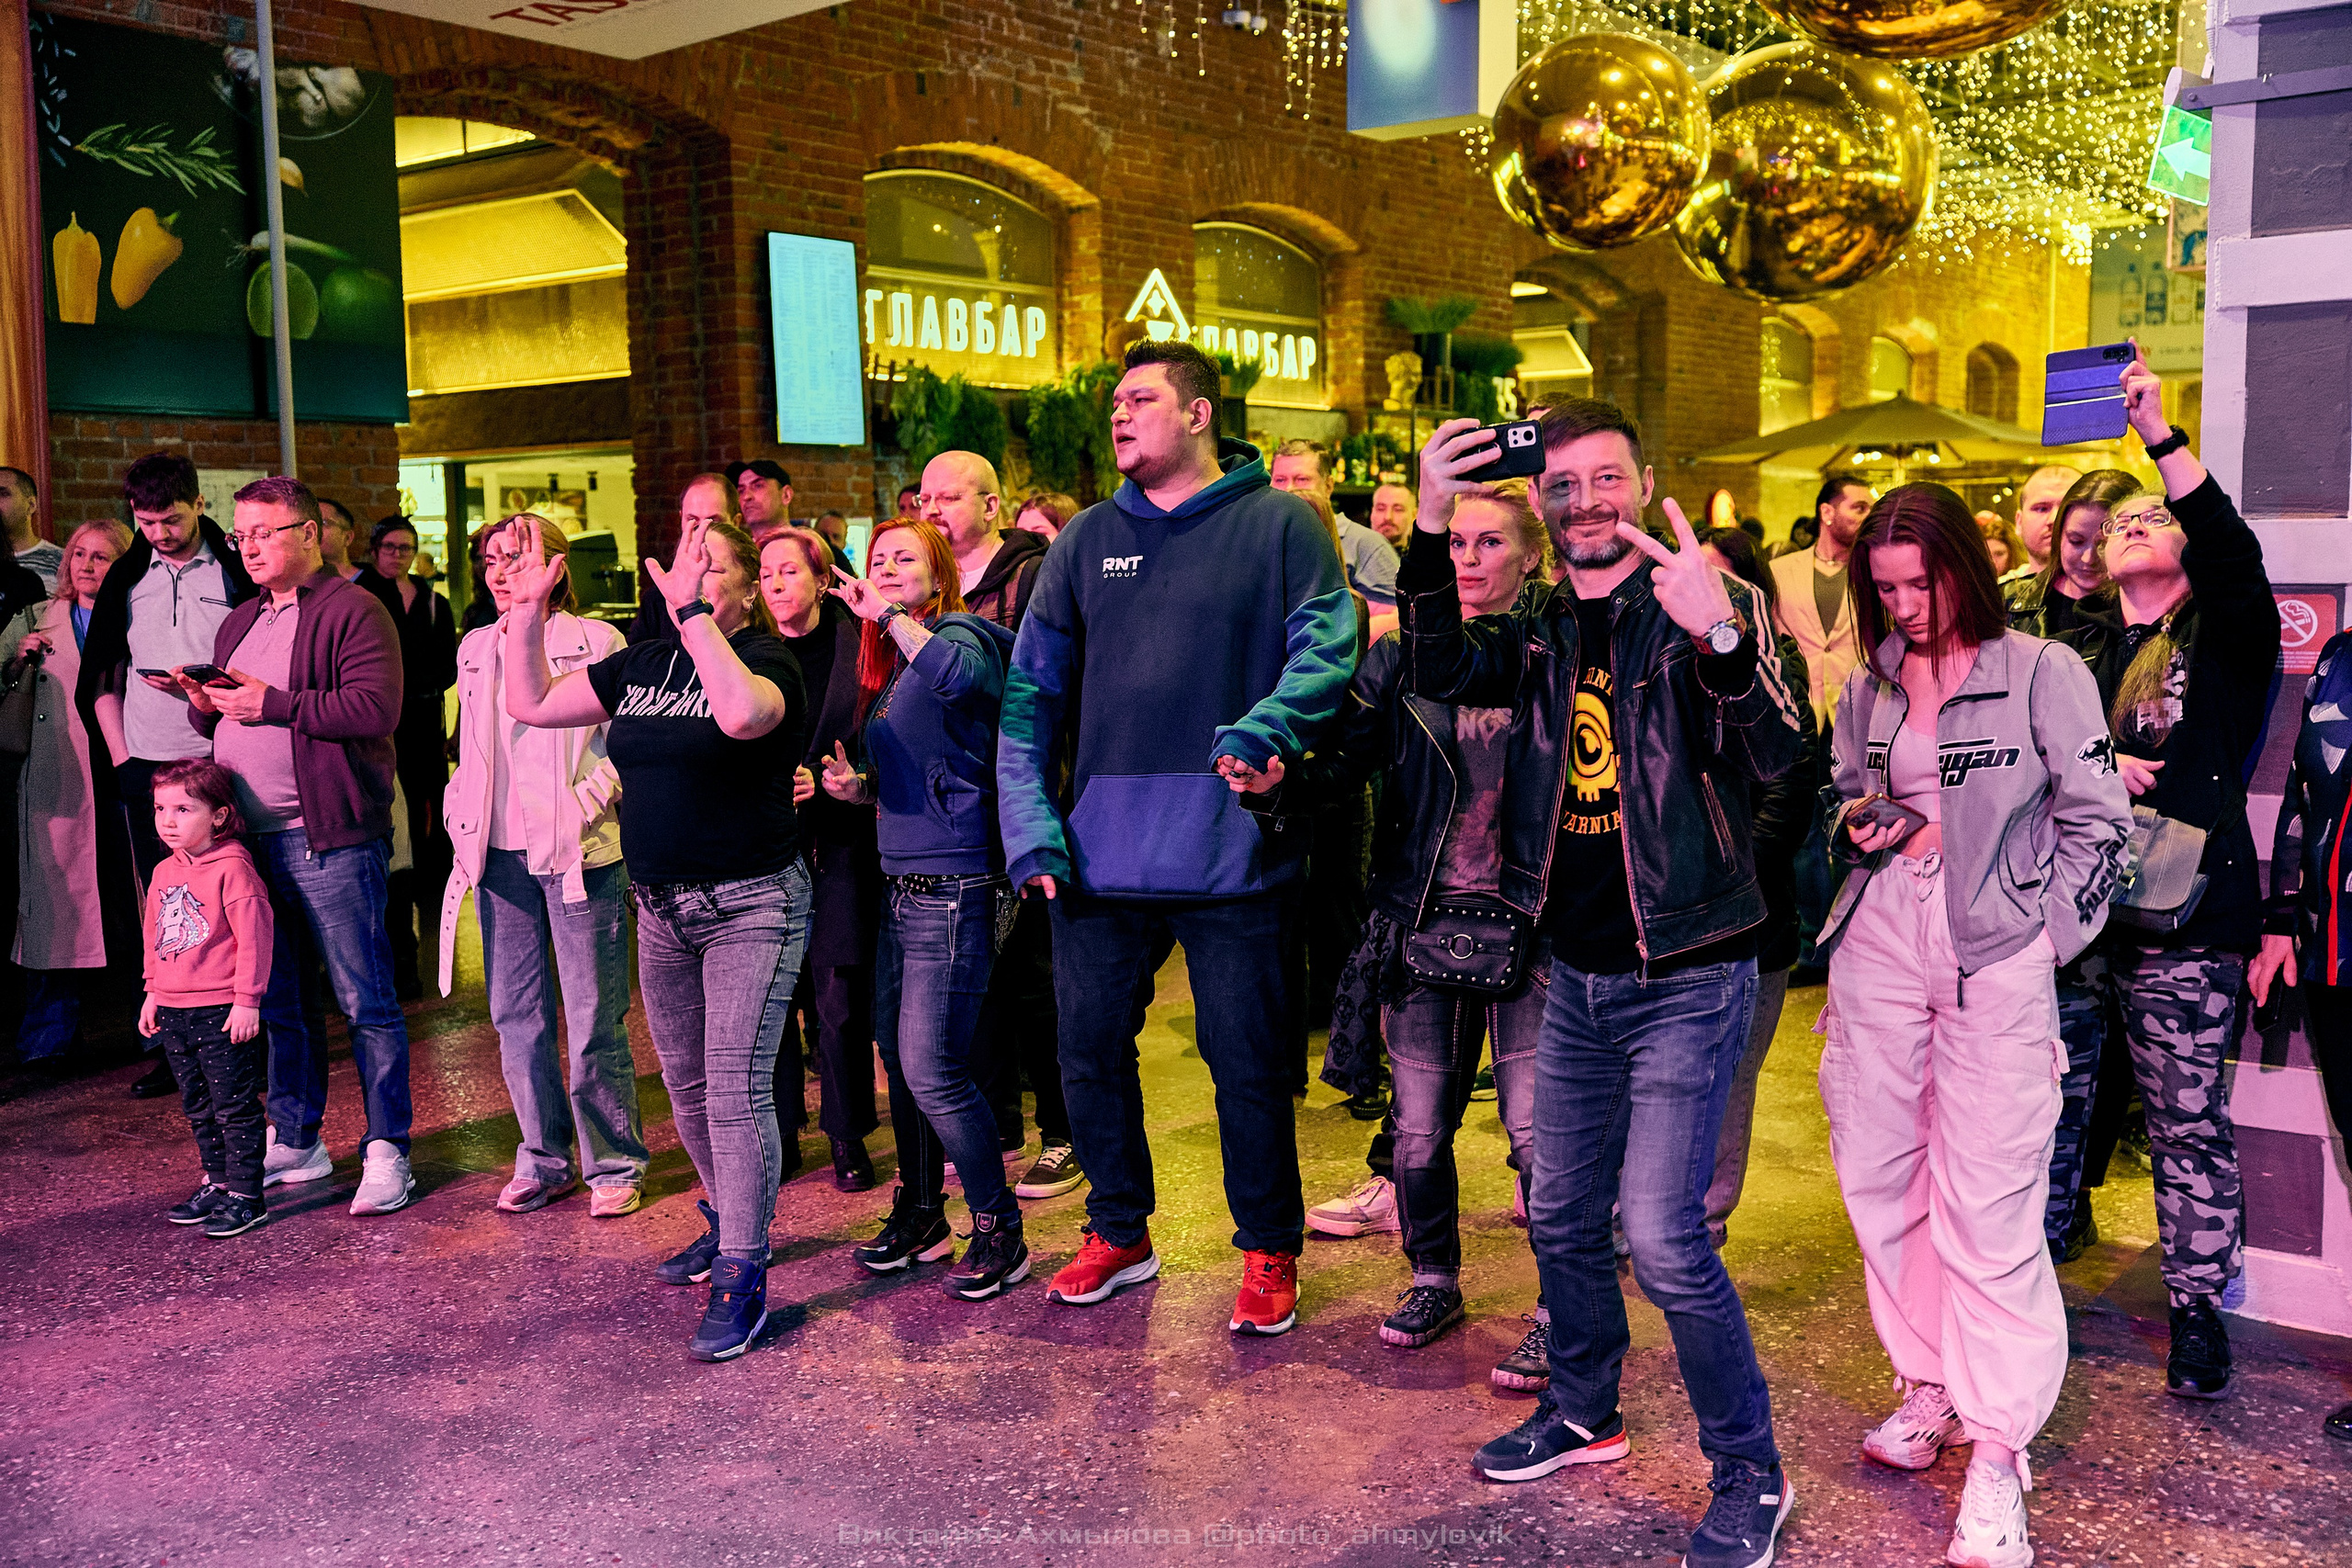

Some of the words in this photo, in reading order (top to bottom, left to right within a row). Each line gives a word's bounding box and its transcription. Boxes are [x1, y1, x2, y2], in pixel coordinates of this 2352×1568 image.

[865, 288, 1046, 358] ГЛАВБАР
[1192, 324, 1317, 380] ЛАВБАР
[1102, 555, 1144, 572] RNT
